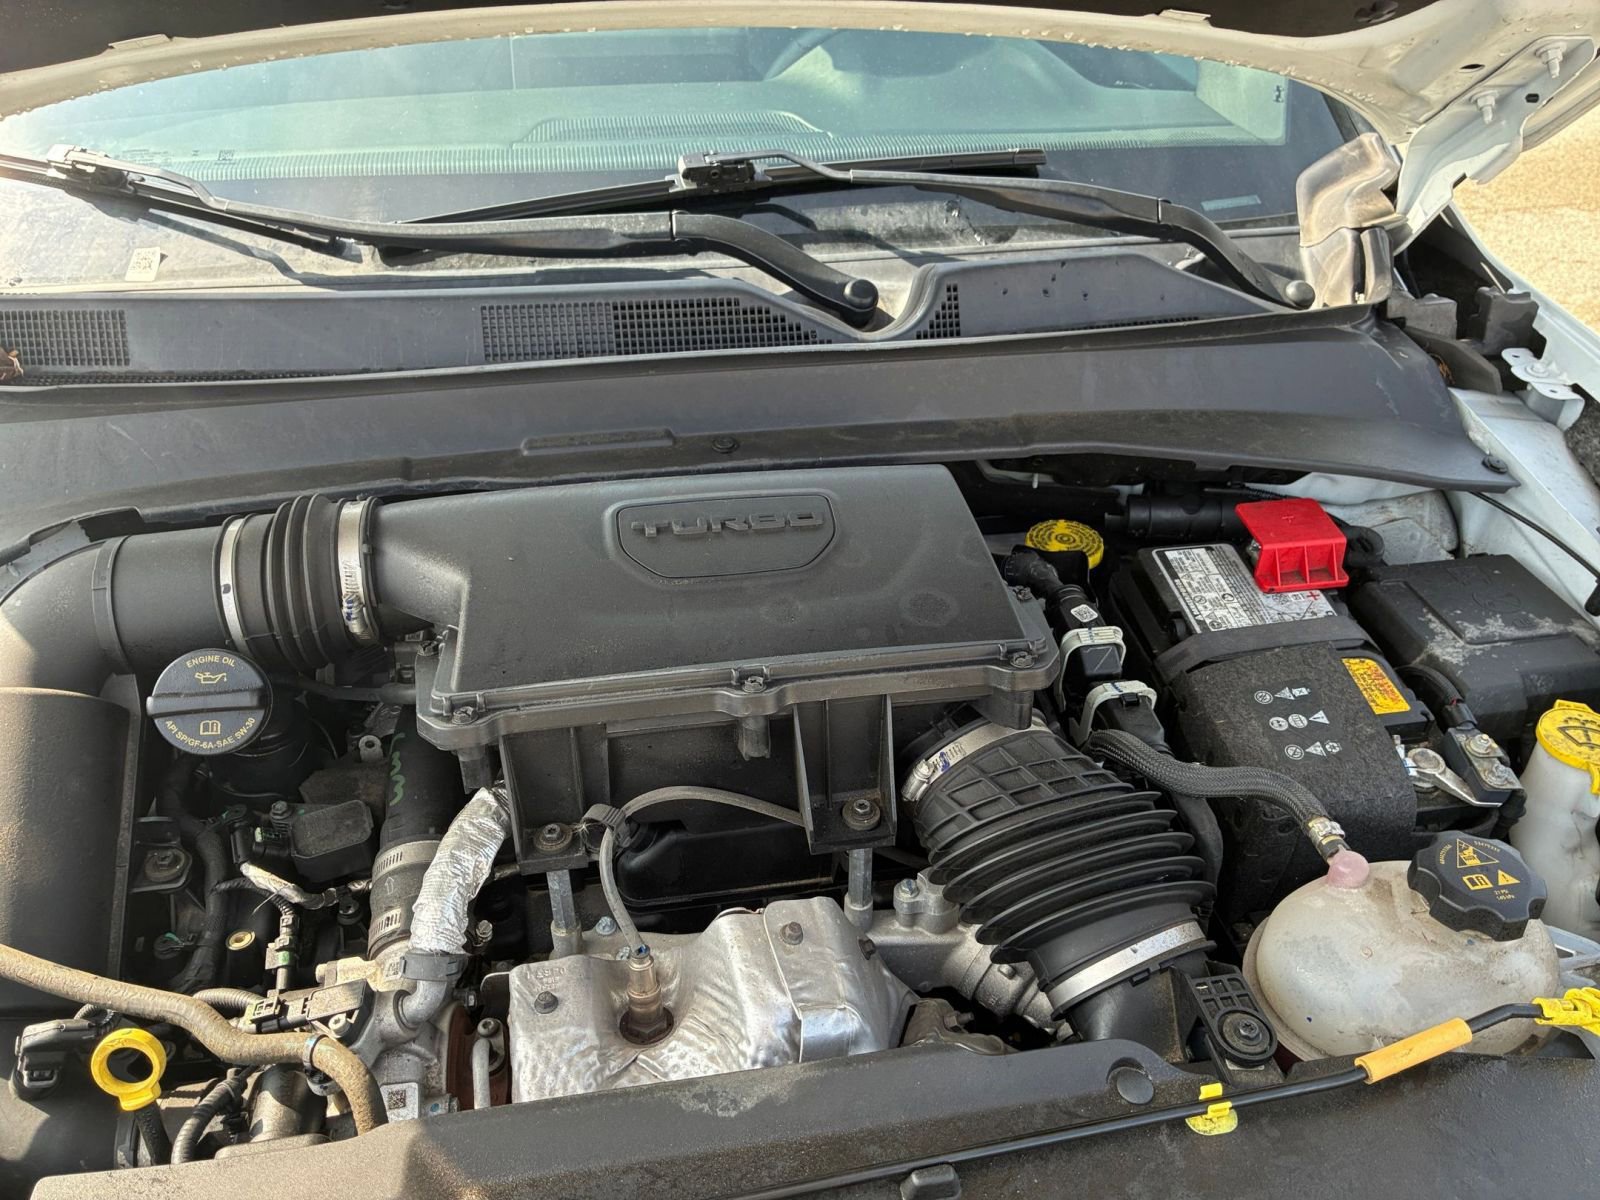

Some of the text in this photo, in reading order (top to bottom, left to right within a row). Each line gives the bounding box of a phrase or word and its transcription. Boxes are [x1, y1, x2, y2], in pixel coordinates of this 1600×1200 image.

[631, 512, 824, 537] TURBO
[186, 655, 236, 668] ENGINE OIL
[166, 720, 178, 734] API
[235, 717, 255, 739] 5W-30
